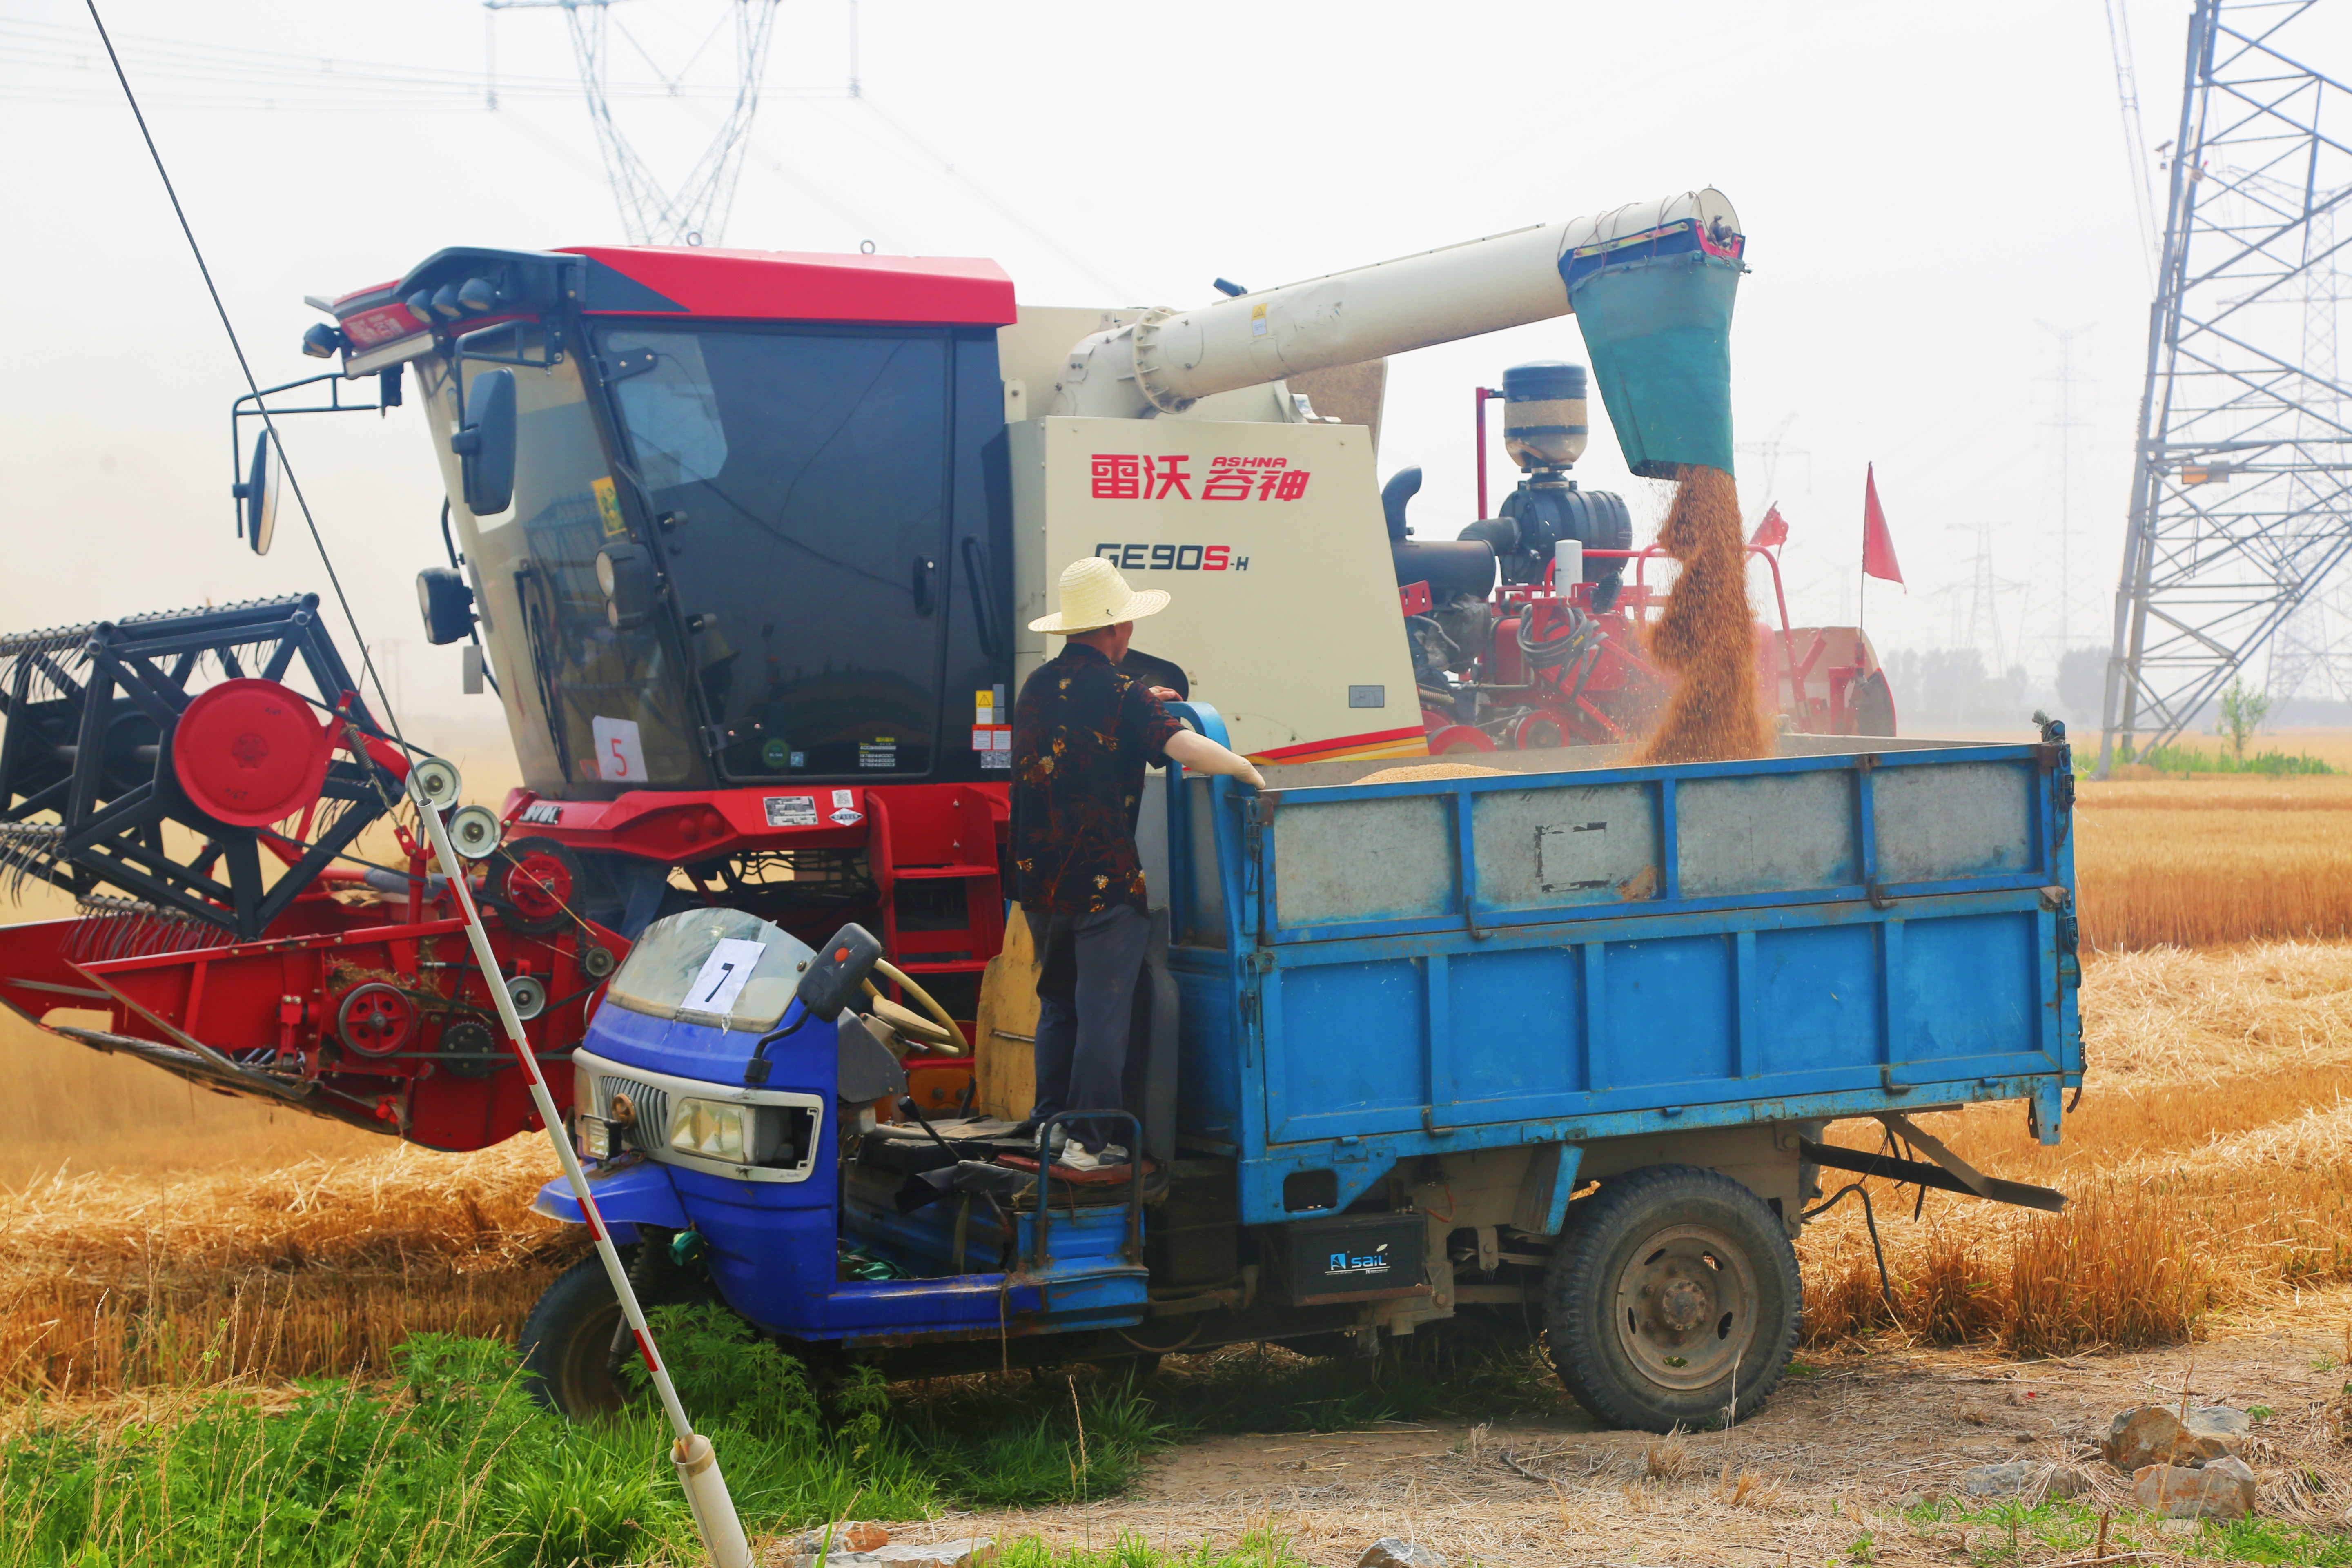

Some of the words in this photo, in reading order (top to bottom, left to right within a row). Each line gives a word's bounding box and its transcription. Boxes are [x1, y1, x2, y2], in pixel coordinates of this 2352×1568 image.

[1091, 454, 1192, 500] 雷沃
[1201, 469, 1310, 501] 谷神
[1212, 456, 1287, 468] ASHNA
[1095, 543, 1250, 571] GE90S-H
[610, 738, 627, 777] 5
[704, 962, 735, 1002] 7
